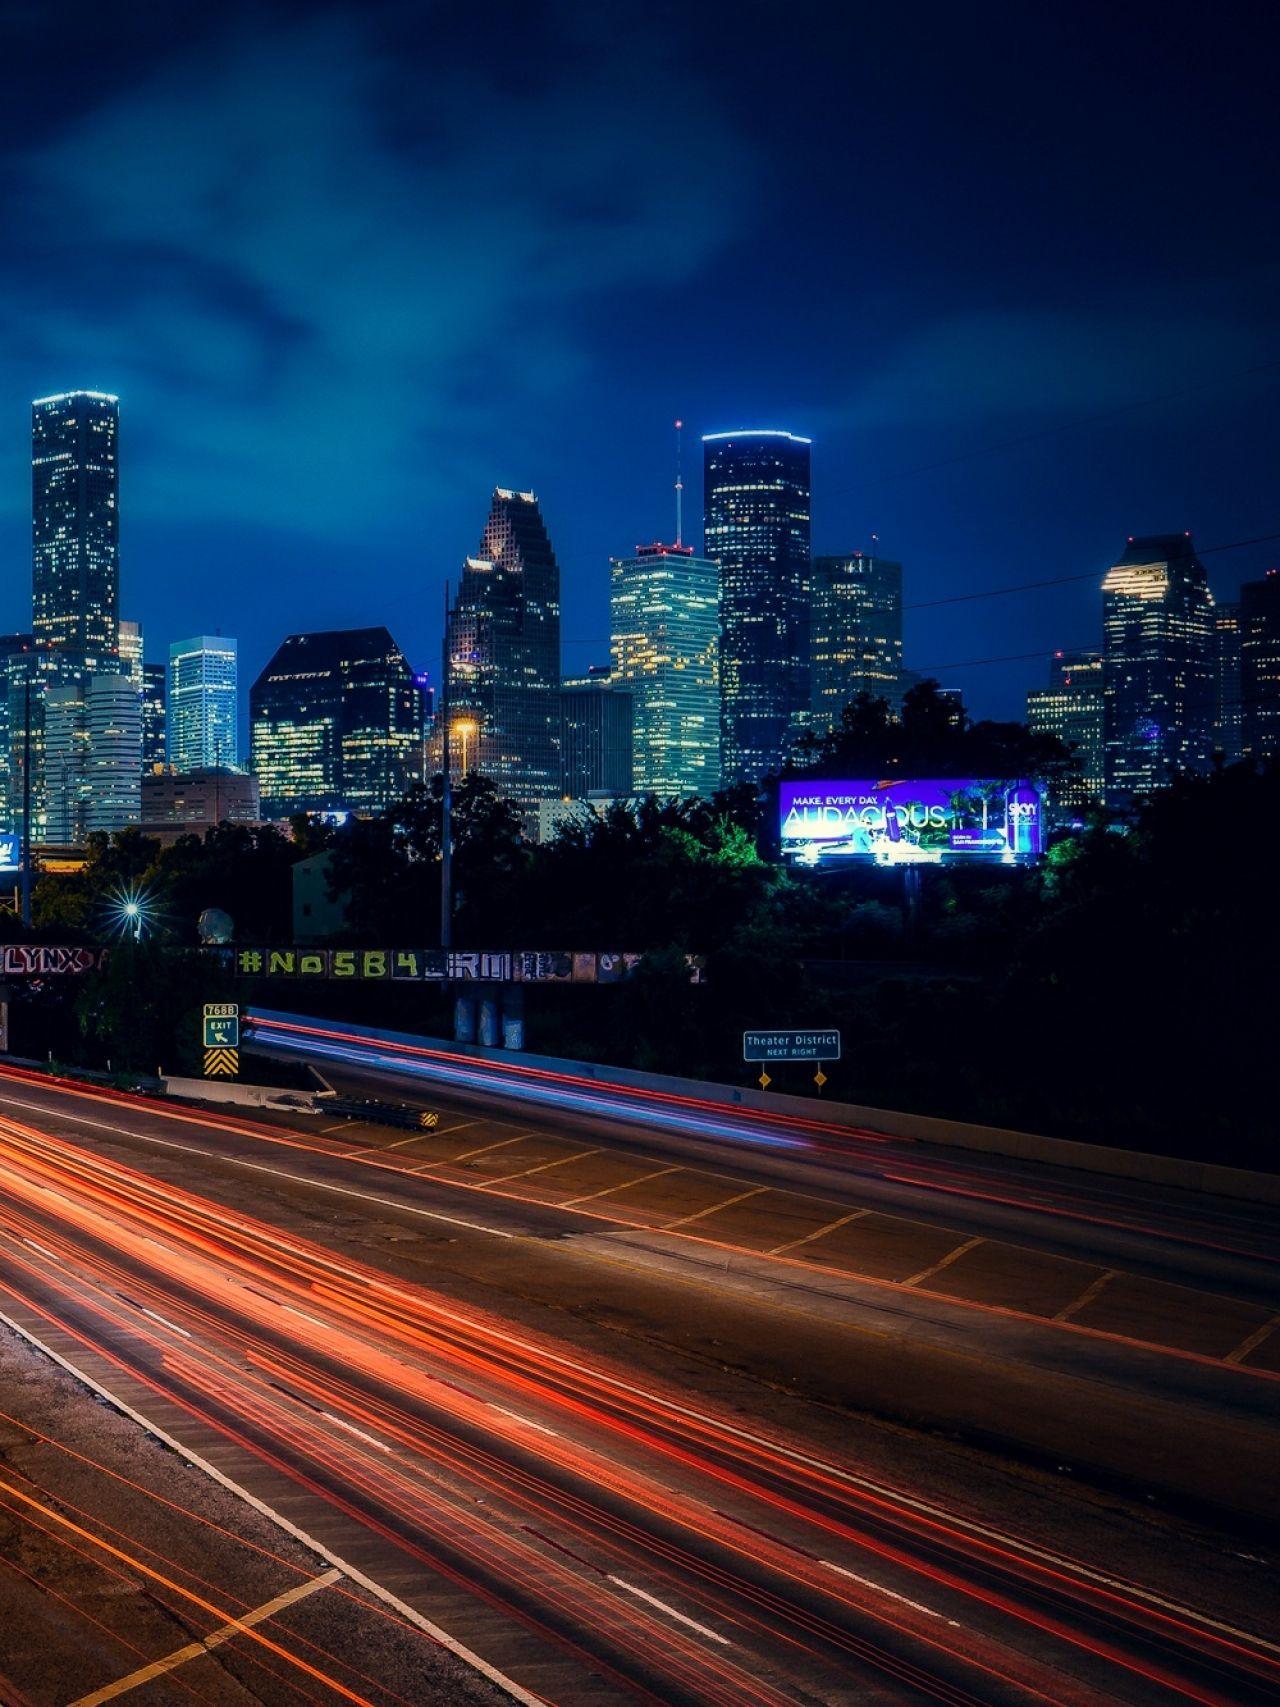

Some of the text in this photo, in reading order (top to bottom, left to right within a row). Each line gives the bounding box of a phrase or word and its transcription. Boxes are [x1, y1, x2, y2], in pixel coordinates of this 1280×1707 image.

[826, 796, 856, 805] EVERY
[4, 947, 84, 973] LYNX
[210, 1021, 232, 1030] EXIT
[747, 1034, 837, 1046] Theater District
[766, 1047, 817, 1056] NEXT RIGHT
